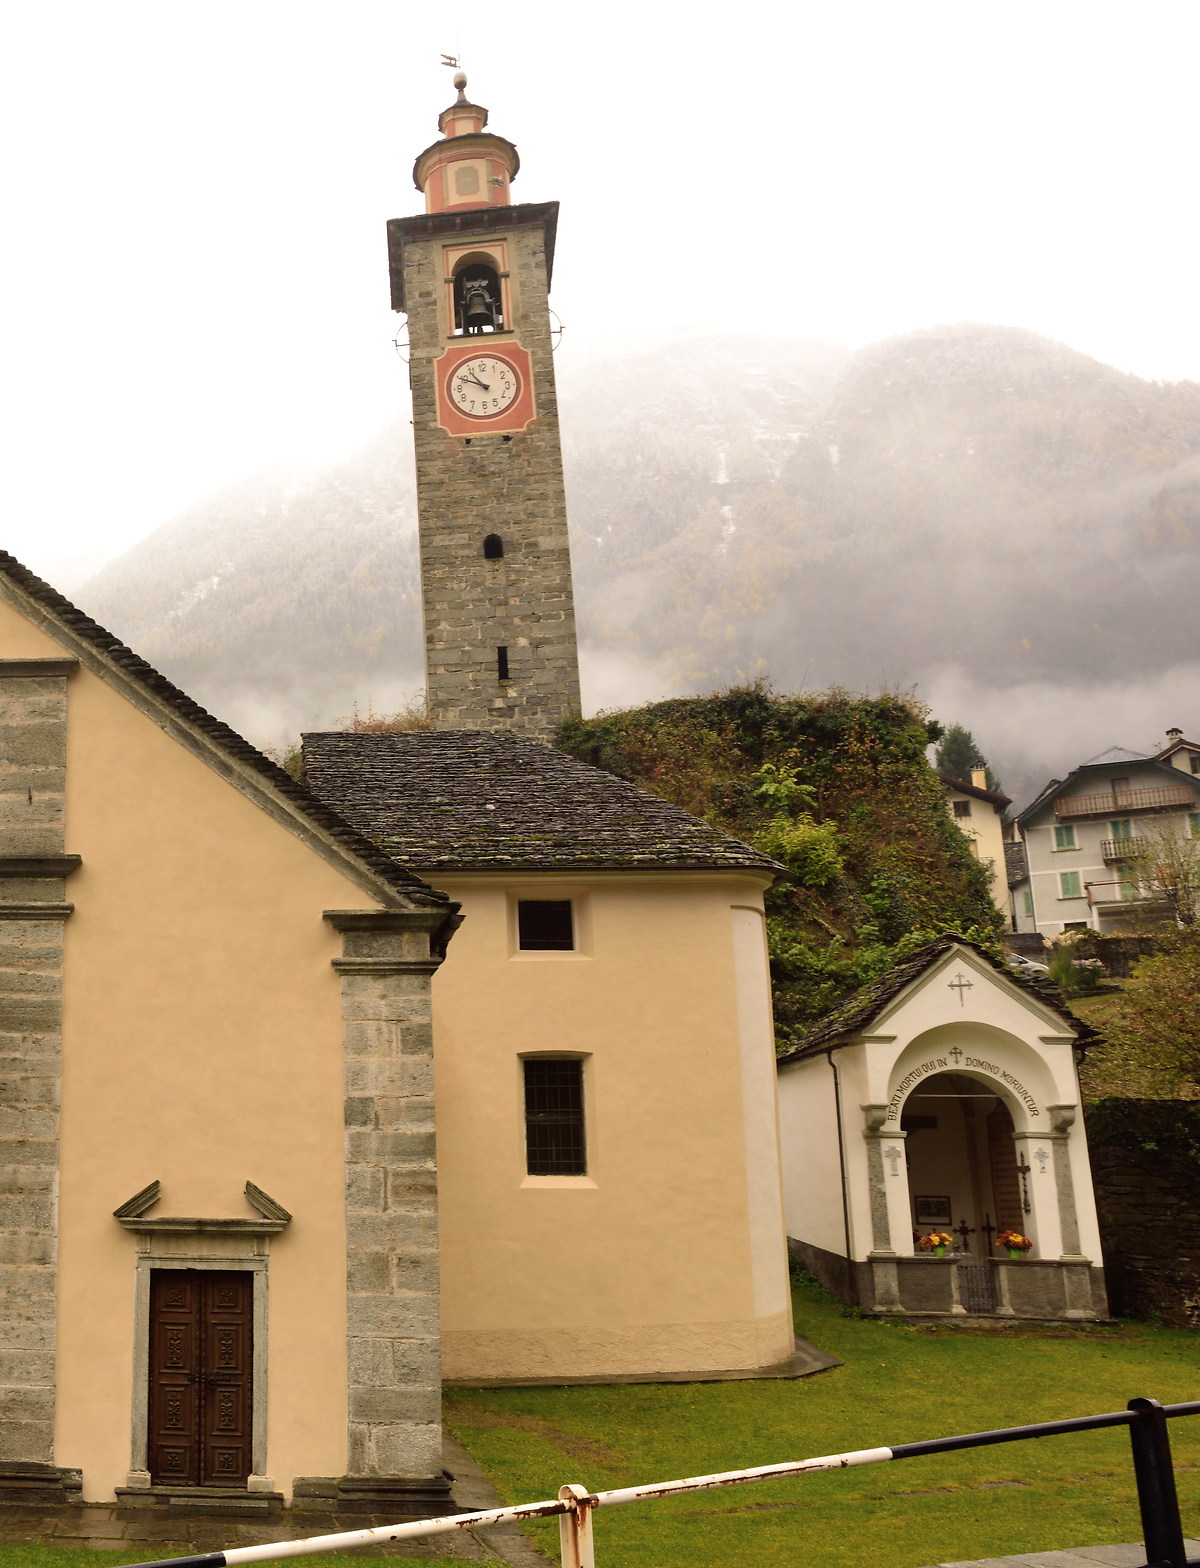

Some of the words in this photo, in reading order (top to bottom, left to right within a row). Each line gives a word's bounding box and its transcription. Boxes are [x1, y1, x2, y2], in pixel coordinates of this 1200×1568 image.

[478, 363, 486, 372] 12
[499, 370, 506, 380] 2
[457, 384, 463, 393] 9
[504, 381, 511, 390] 3
[461, 393, 467, 402] 8
[482, 400, 488, 410] 6
[492, 398, 499, 407] 5
[888, 1094, 902, 1121] BEATI
[896, 1067, 923, 1095] MORTUI
[936, 1058, 947, 1068] IN
[965, 1057, 1000, 1075] DOMINO
[1000, 1070, 1040, 1117] MORIUNTUR
